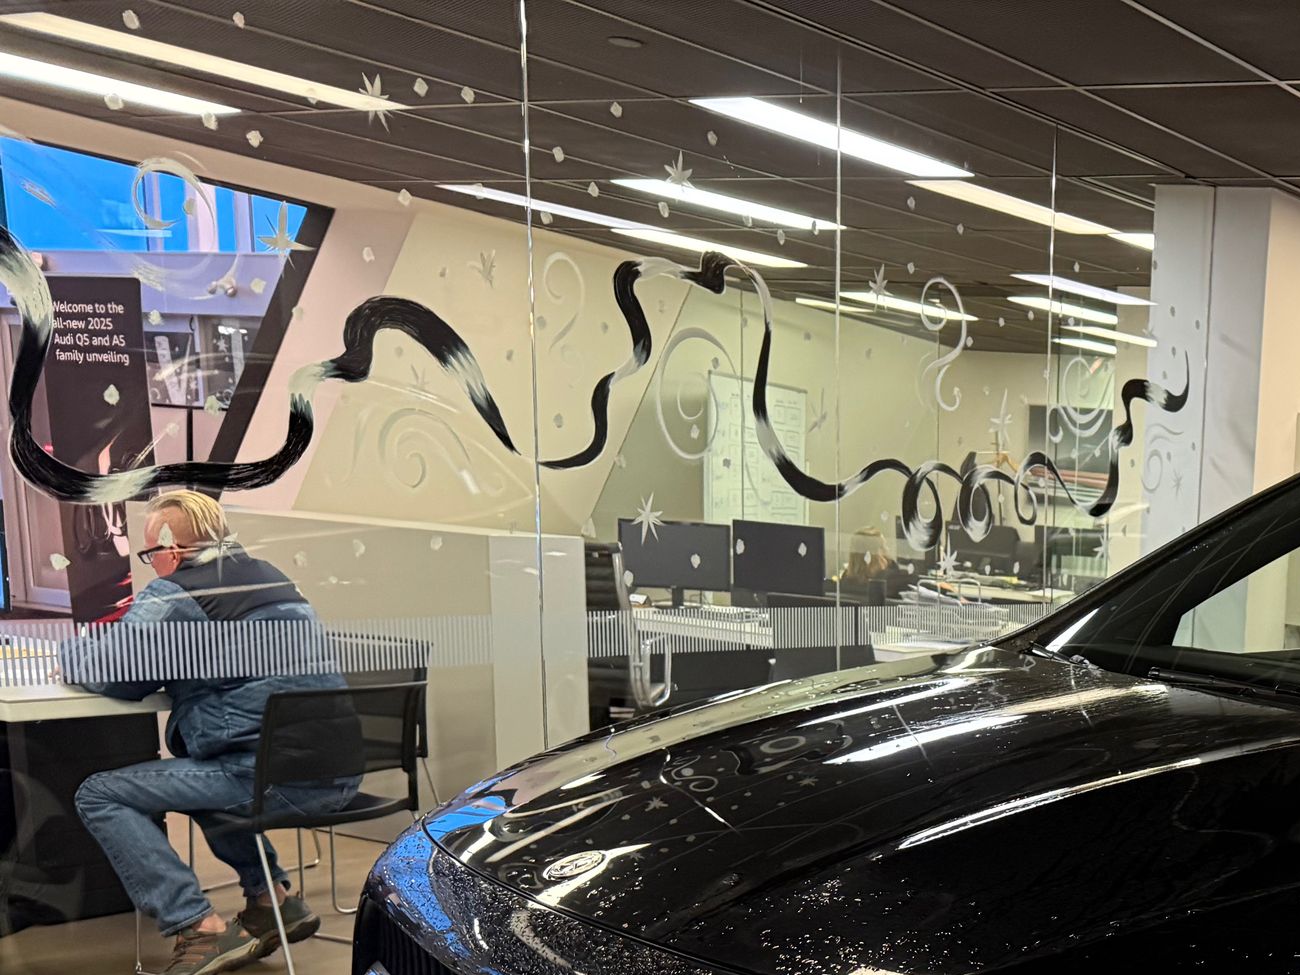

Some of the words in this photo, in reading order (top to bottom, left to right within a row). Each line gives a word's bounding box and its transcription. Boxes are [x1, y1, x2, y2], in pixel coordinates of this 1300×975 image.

[53, 301, 93, 313] Welcome
[95, 302, 106, 314] to
[107, 301, 124, 314] the
[53, 317, 86, 329] all-new
[88, 318, 113, 329] 2025
[54, 333, 74, 345] Audi
[75, 333, 90, 347] Q5
[91, 334, 110, 346] and
[111, 334, 126, 347] A5
[56, 349, 84, 364] family
[86, 351, 130, 366] unveiling
